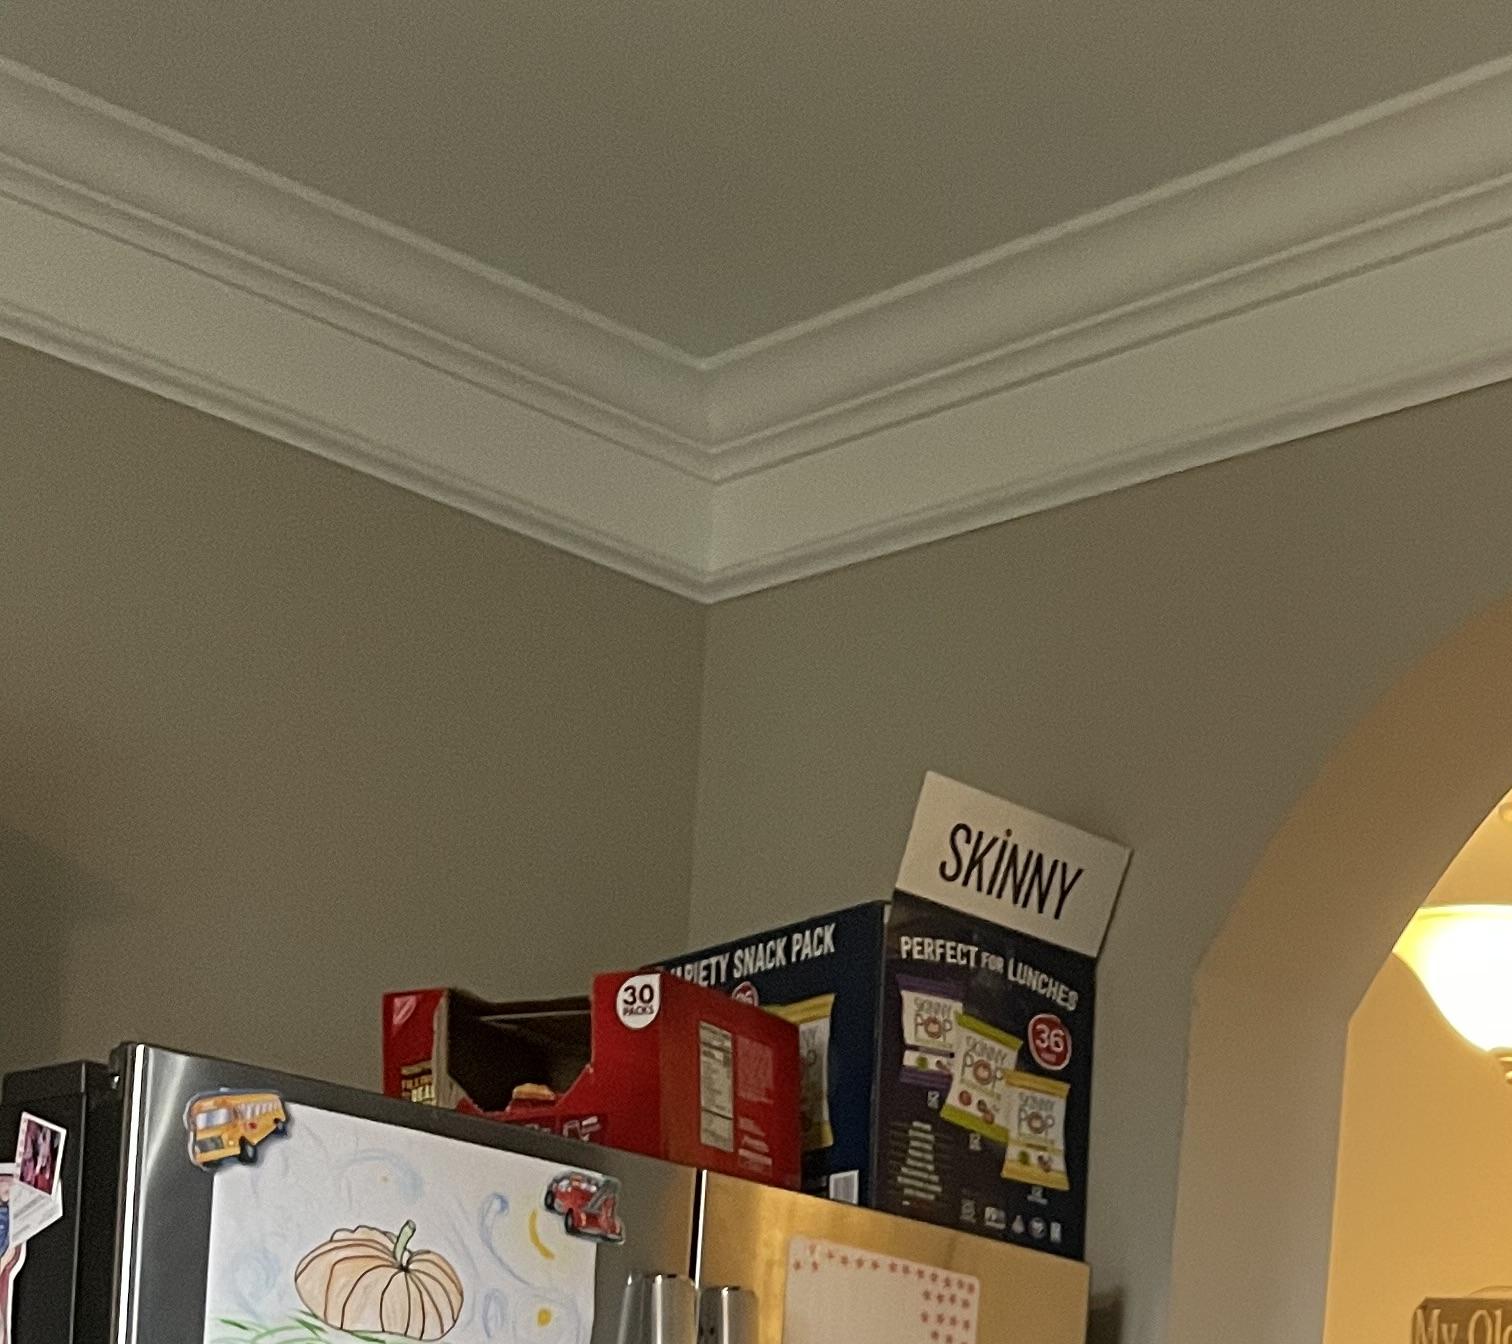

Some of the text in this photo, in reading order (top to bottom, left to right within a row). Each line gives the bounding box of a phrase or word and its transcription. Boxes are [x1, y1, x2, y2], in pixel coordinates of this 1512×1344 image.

[938, 823, 1084, 920] SKINNY
[733, 936, 788, 979] SNACK
[790, 922, 837, 963] PACK
[622, 983, 655, 1006] 30
[900, 935, 1079, 1012] PERFECT FOR LUNCHES
[622, 1004, 655, 1017] PACKS
[1034, 1023, 1065, 1053] 36
